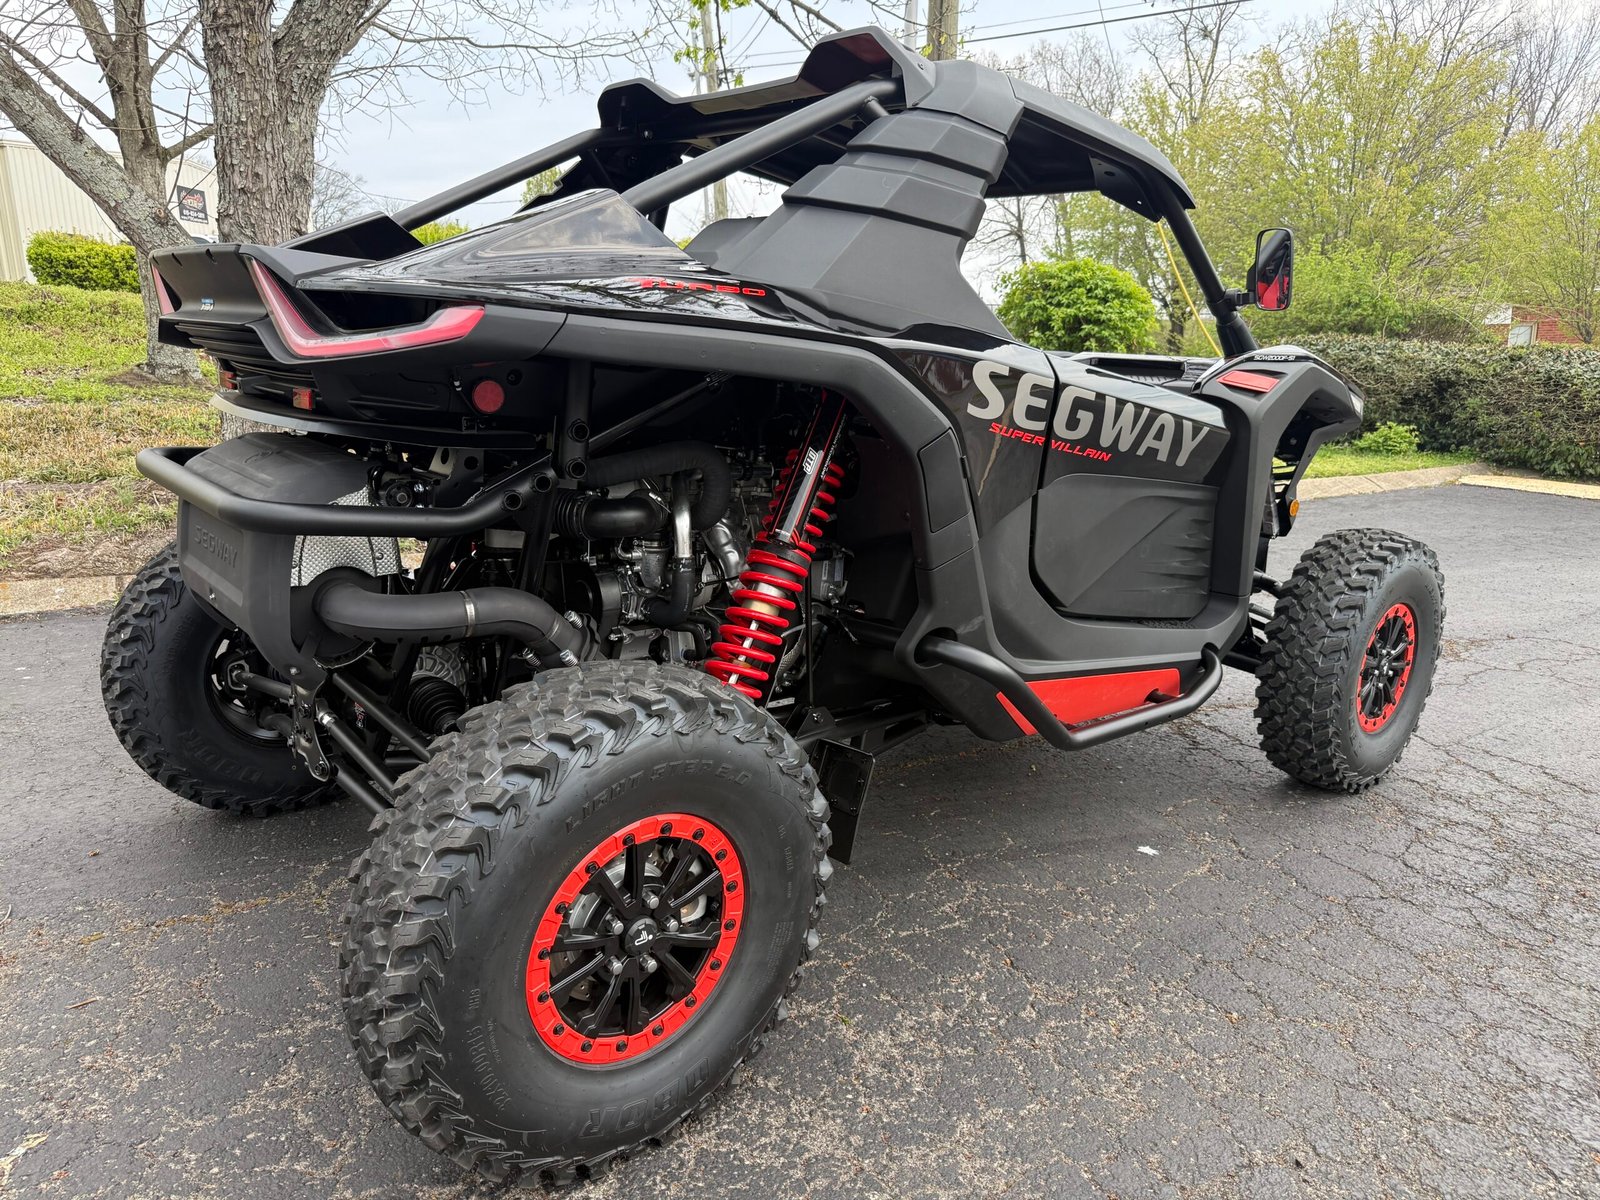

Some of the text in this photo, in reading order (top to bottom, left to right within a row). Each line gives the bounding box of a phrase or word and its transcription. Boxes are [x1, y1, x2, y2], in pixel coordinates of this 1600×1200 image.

[626, 277, 766, 297] TURBO
[966, 360, 1210, 467] SEGWAY
[988, 422, 1112, 463] SUPER VILLAIN
[193, 523, 238, 569] SEGWAY
[565, 758, 752, 835] LIGHT STEP 2.0
